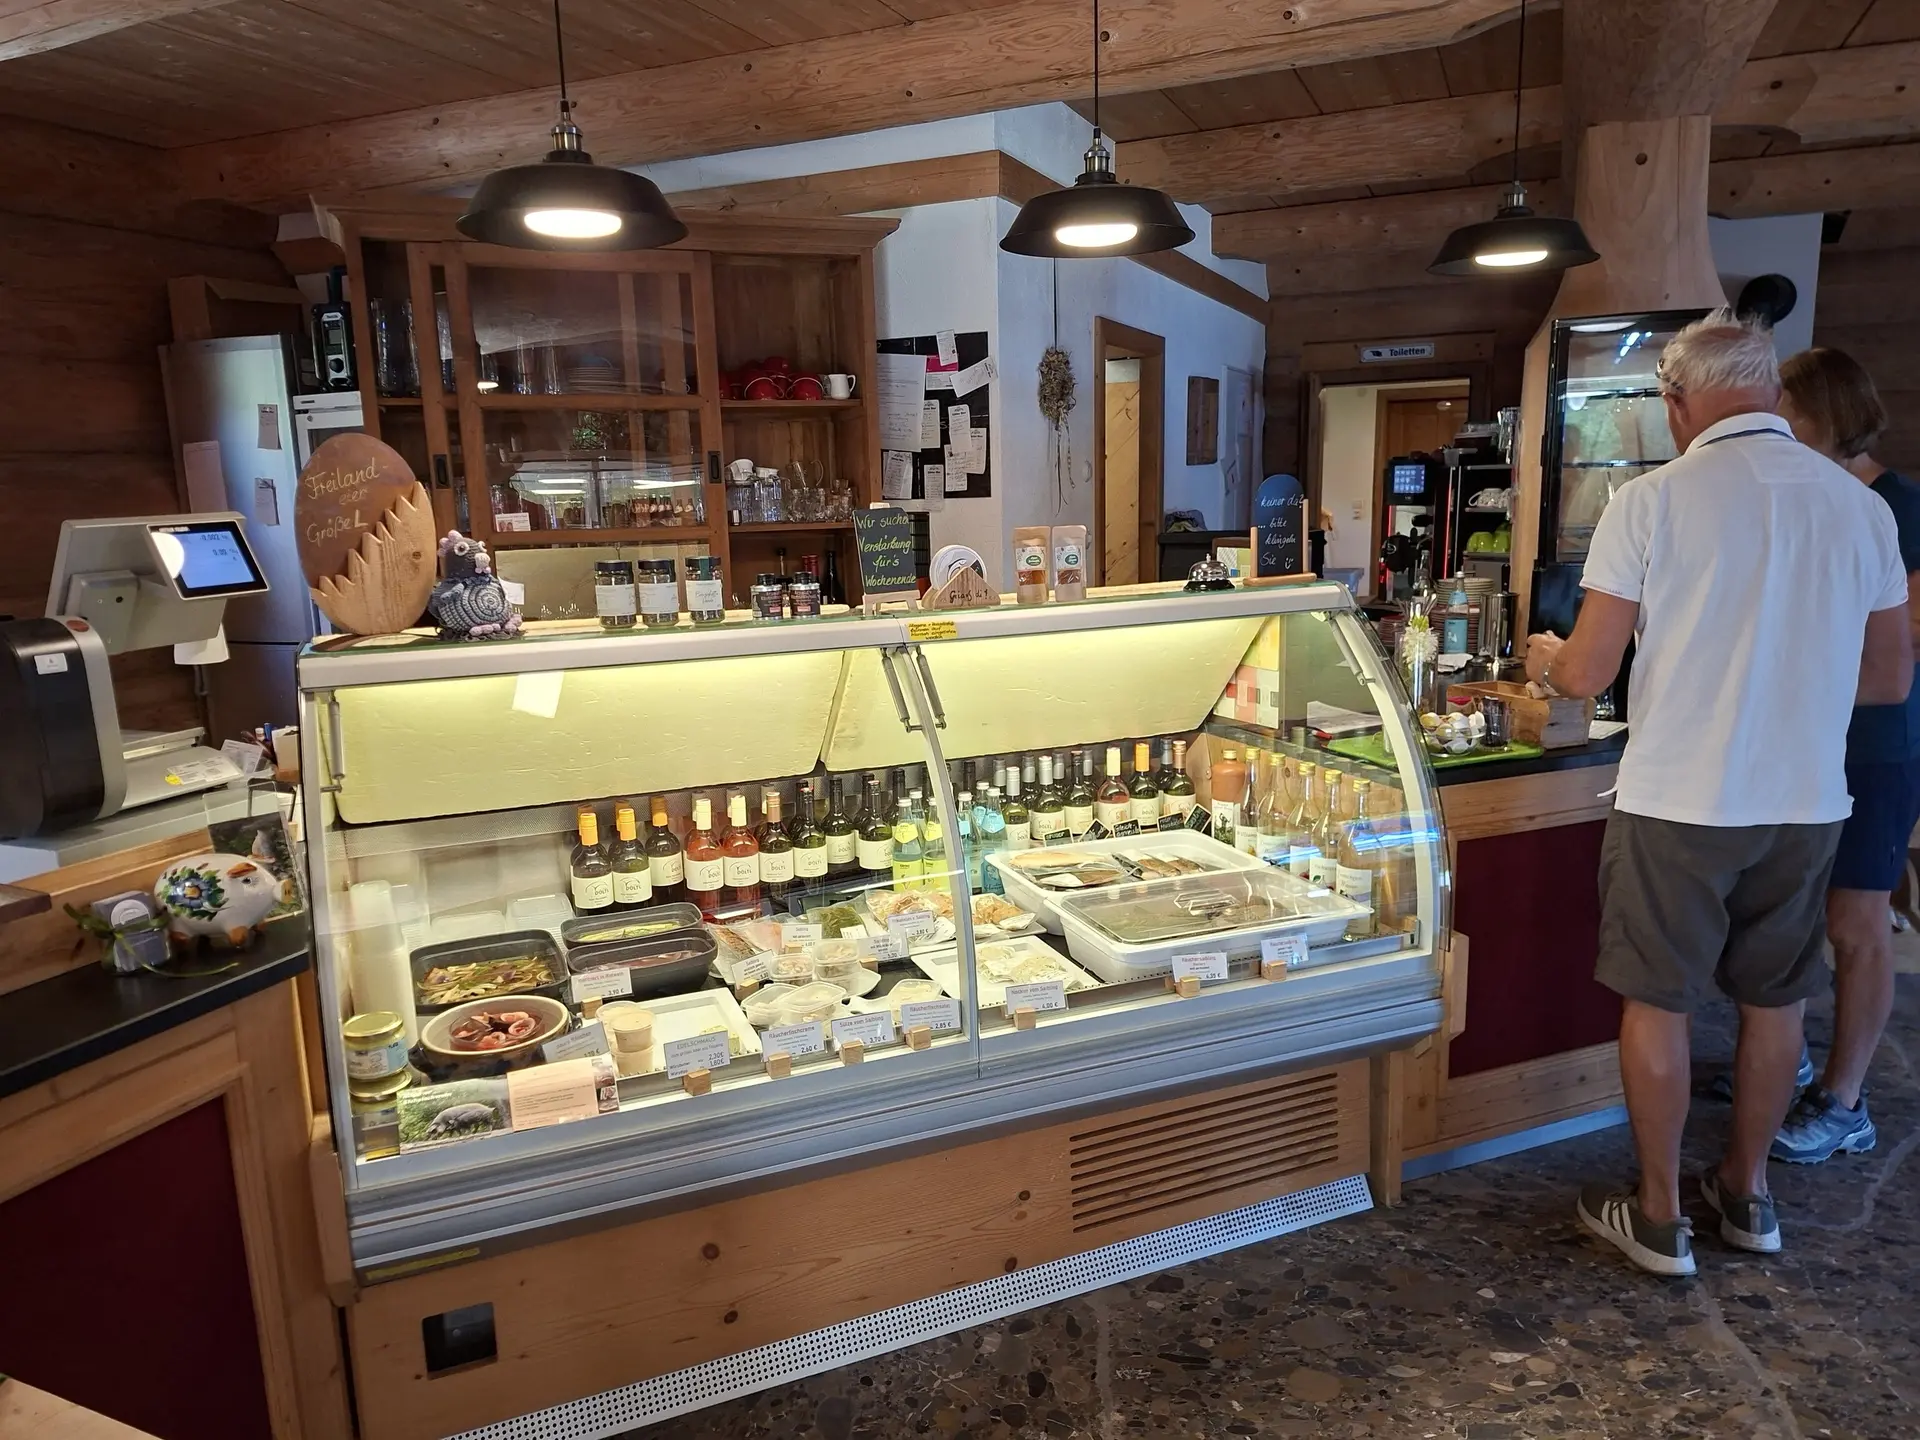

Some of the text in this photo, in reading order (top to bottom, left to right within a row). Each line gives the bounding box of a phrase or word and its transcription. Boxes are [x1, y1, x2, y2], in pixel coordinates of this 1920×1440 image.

[1389, 347, 1426, 357] Toiletten
[339, 488, 367, 505] eier
[1287, 493, 1304, 509] da?
[307, 509, 368, 547] Größe L
[857, 513, 875, 529] Wir
[1269, 517, 1287, 528] bitte
[859, 534, 911, 555] Verstärkung
[1265, 534, 1296, 549] klingeln
[872, 554, 900, 573] für's
[1261, 552, 1276, 566] Sie
[865, 573, 917, 587] Wochenende
[768, 1026, 815, 1039] Räucherfischcreme
